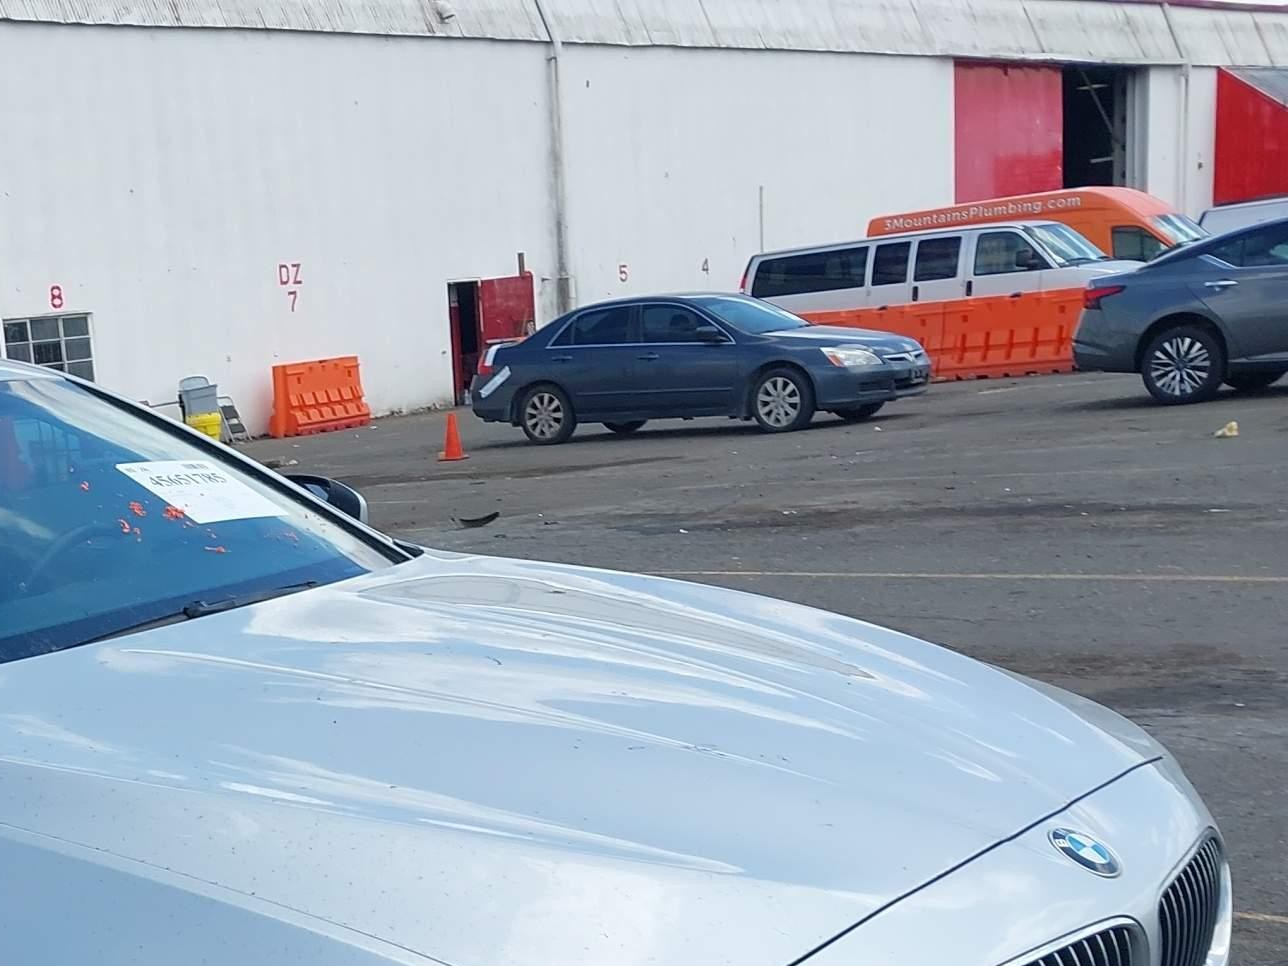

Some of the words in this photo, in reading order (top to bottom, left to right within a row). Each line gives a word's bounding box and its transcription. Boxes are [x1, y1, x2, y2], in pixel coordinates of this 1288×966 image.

[883, 196, 1081, 231] 3MountainsPlumbing.com
[278, 263, 303, 285] DZ
[618, 264, 628, 282] 5
[50, 285, 63, 308] 8
[287, 290, 297, 312] 7
[149, 472, 228, 488] 45651785
